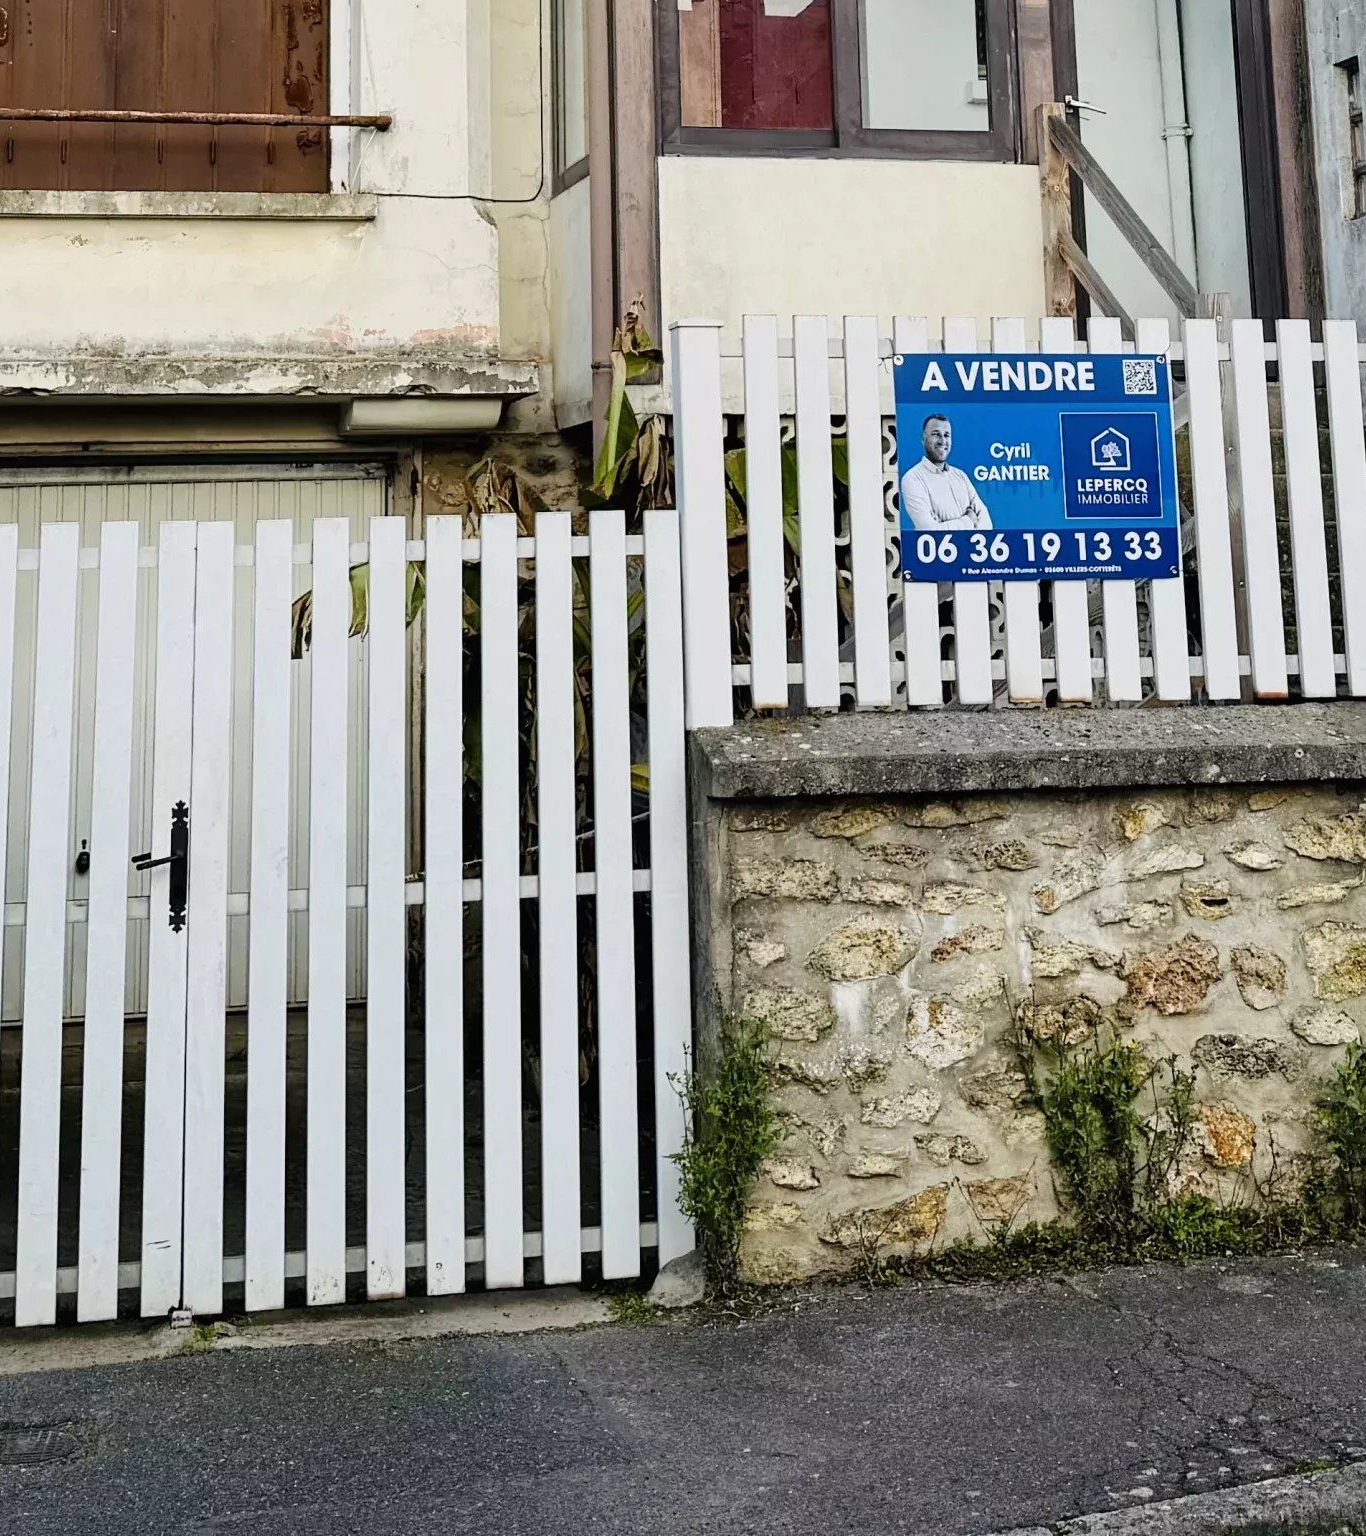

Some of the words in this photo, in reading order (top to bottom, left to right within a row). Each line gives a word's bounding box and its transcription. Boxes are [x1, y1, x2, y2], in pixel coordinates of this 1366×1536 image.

[920, 360, 949, 392] A
[955, 361, 1096, 392] VENDRE
[989, 441, 1031, 462] Cyril
[973, 464, 1050, 482] GANTIER
[1077, 477, 1149, 495] LEPERCQ
[1077, 494, 1149, 505] IMMOBILIER
[916, 533, 958, 564] 06
[969, 533, 1010, 563] 36
[1022, 532, 1061, 563] 19
[1074, 531, 1112, 562] 13
[1124, 531, 1163, 561] 33
